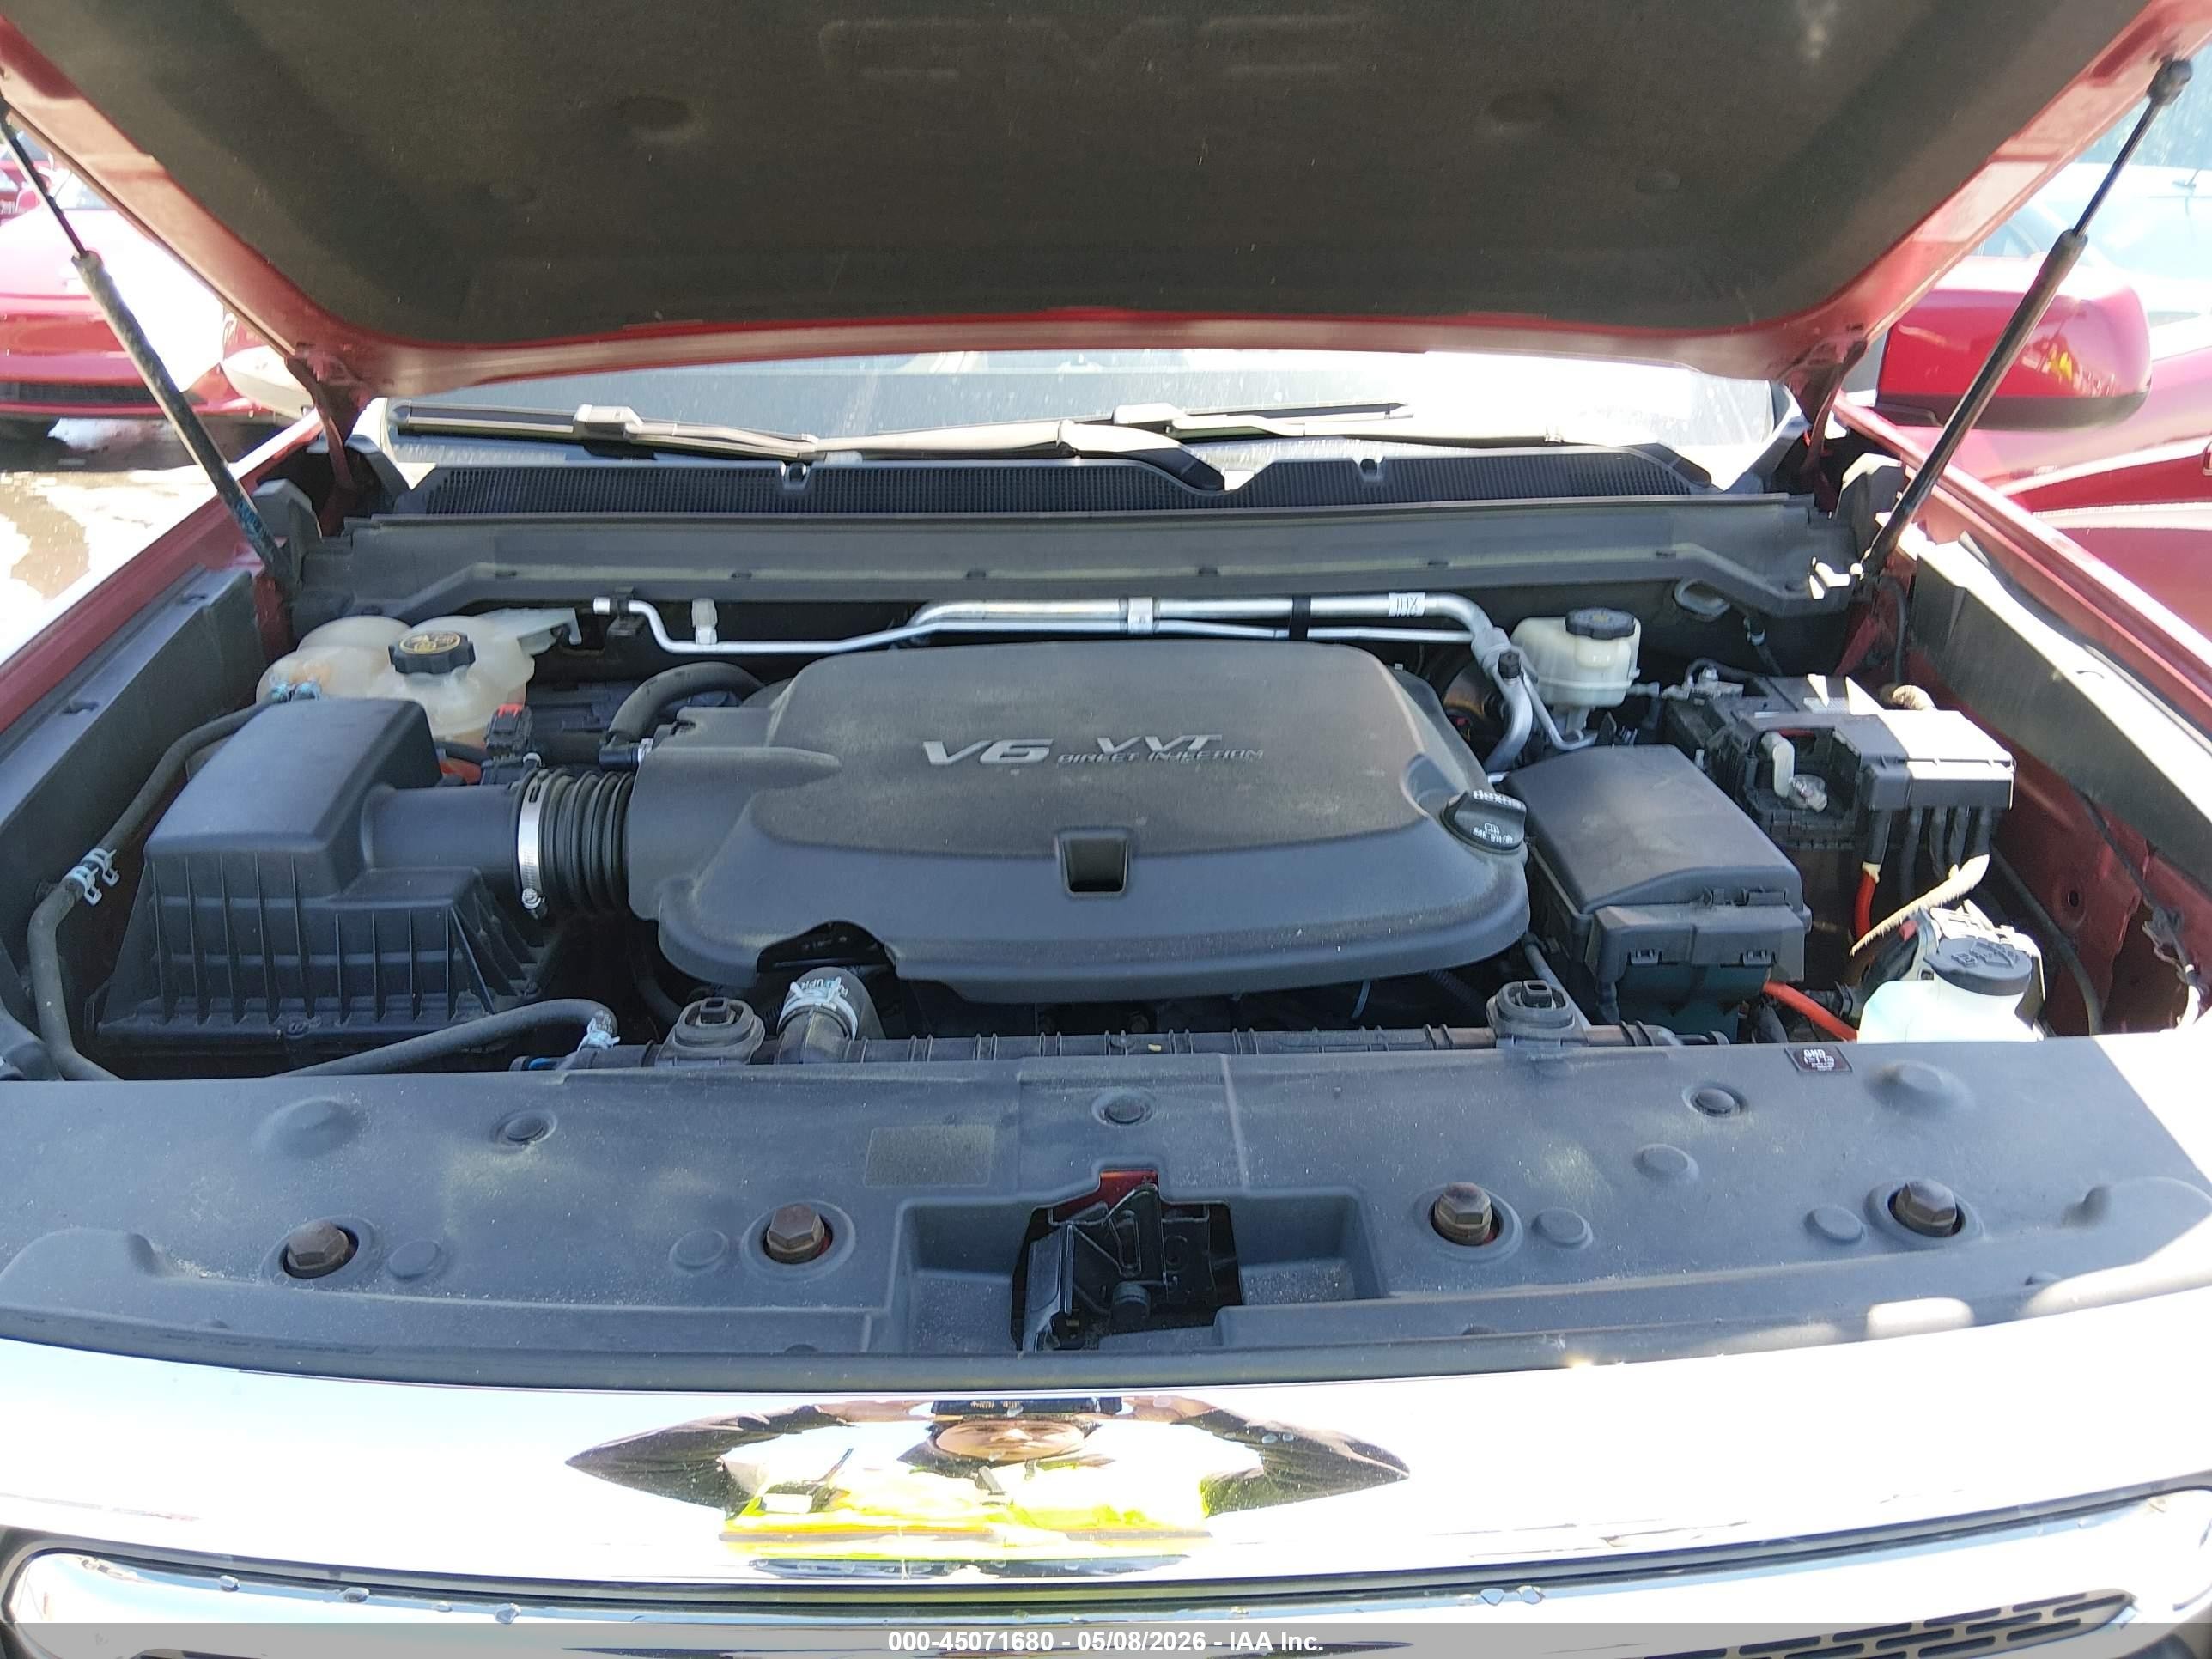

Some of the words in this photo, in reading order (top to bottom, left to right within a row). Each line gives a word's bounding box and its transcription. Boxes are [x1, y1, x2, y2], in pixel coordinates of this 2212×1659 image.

[922, 738, 1054, 765] V6
[1097, 734, 1222, 754] VVT
[1057, 753, 1140, 763] DIRECT
[1147, 750, 1263, 763] INJECTION
